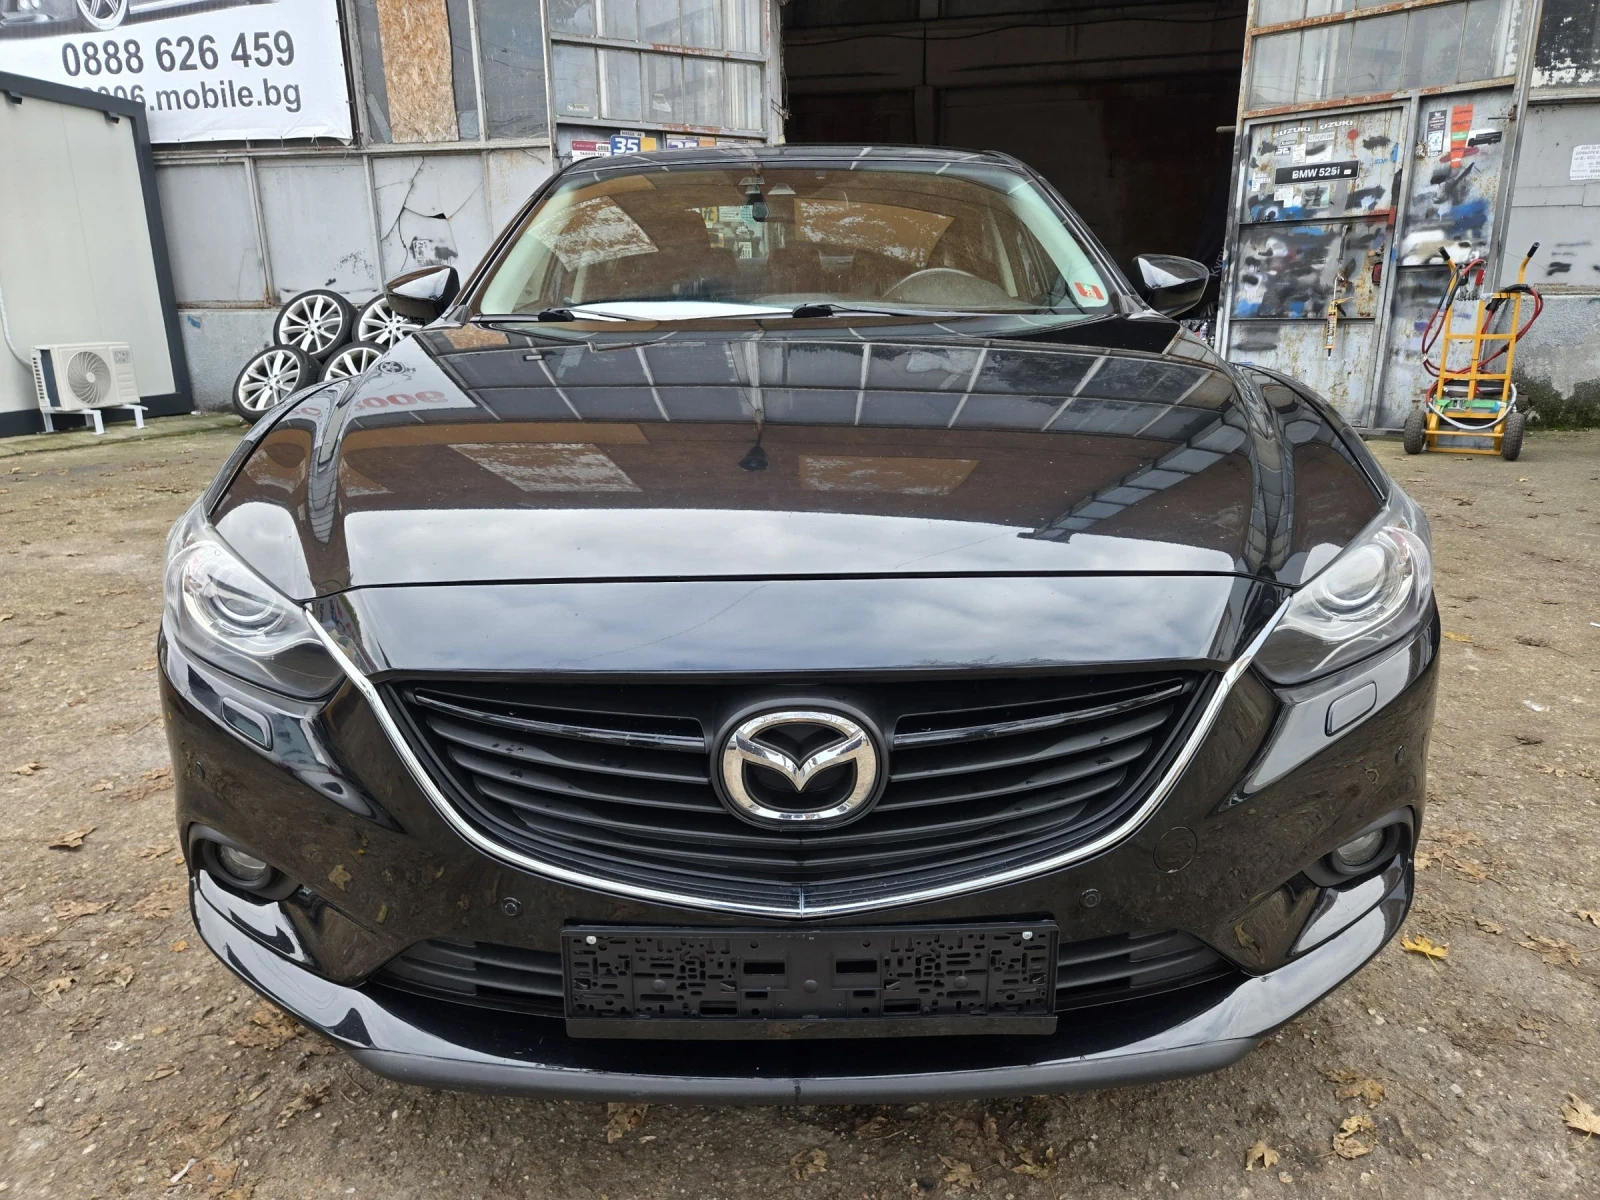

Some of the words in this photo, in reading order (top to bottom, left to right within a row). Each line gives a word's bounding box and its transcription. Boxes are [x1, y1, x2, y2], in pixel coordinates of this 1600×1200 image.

[62, 38, 144, 76] 0888
[155, 34, 219, 73] 626
[231, 30, 295, 68] 459
[1319, 120, 1353, 130] UZUKI
[1273, 126, 1311, 138] SUZUKI
[613, 137, 639, 154] 35
[1292, 169, 1317, 179] BMW
[1318, 166, 1341, 177] 525i
